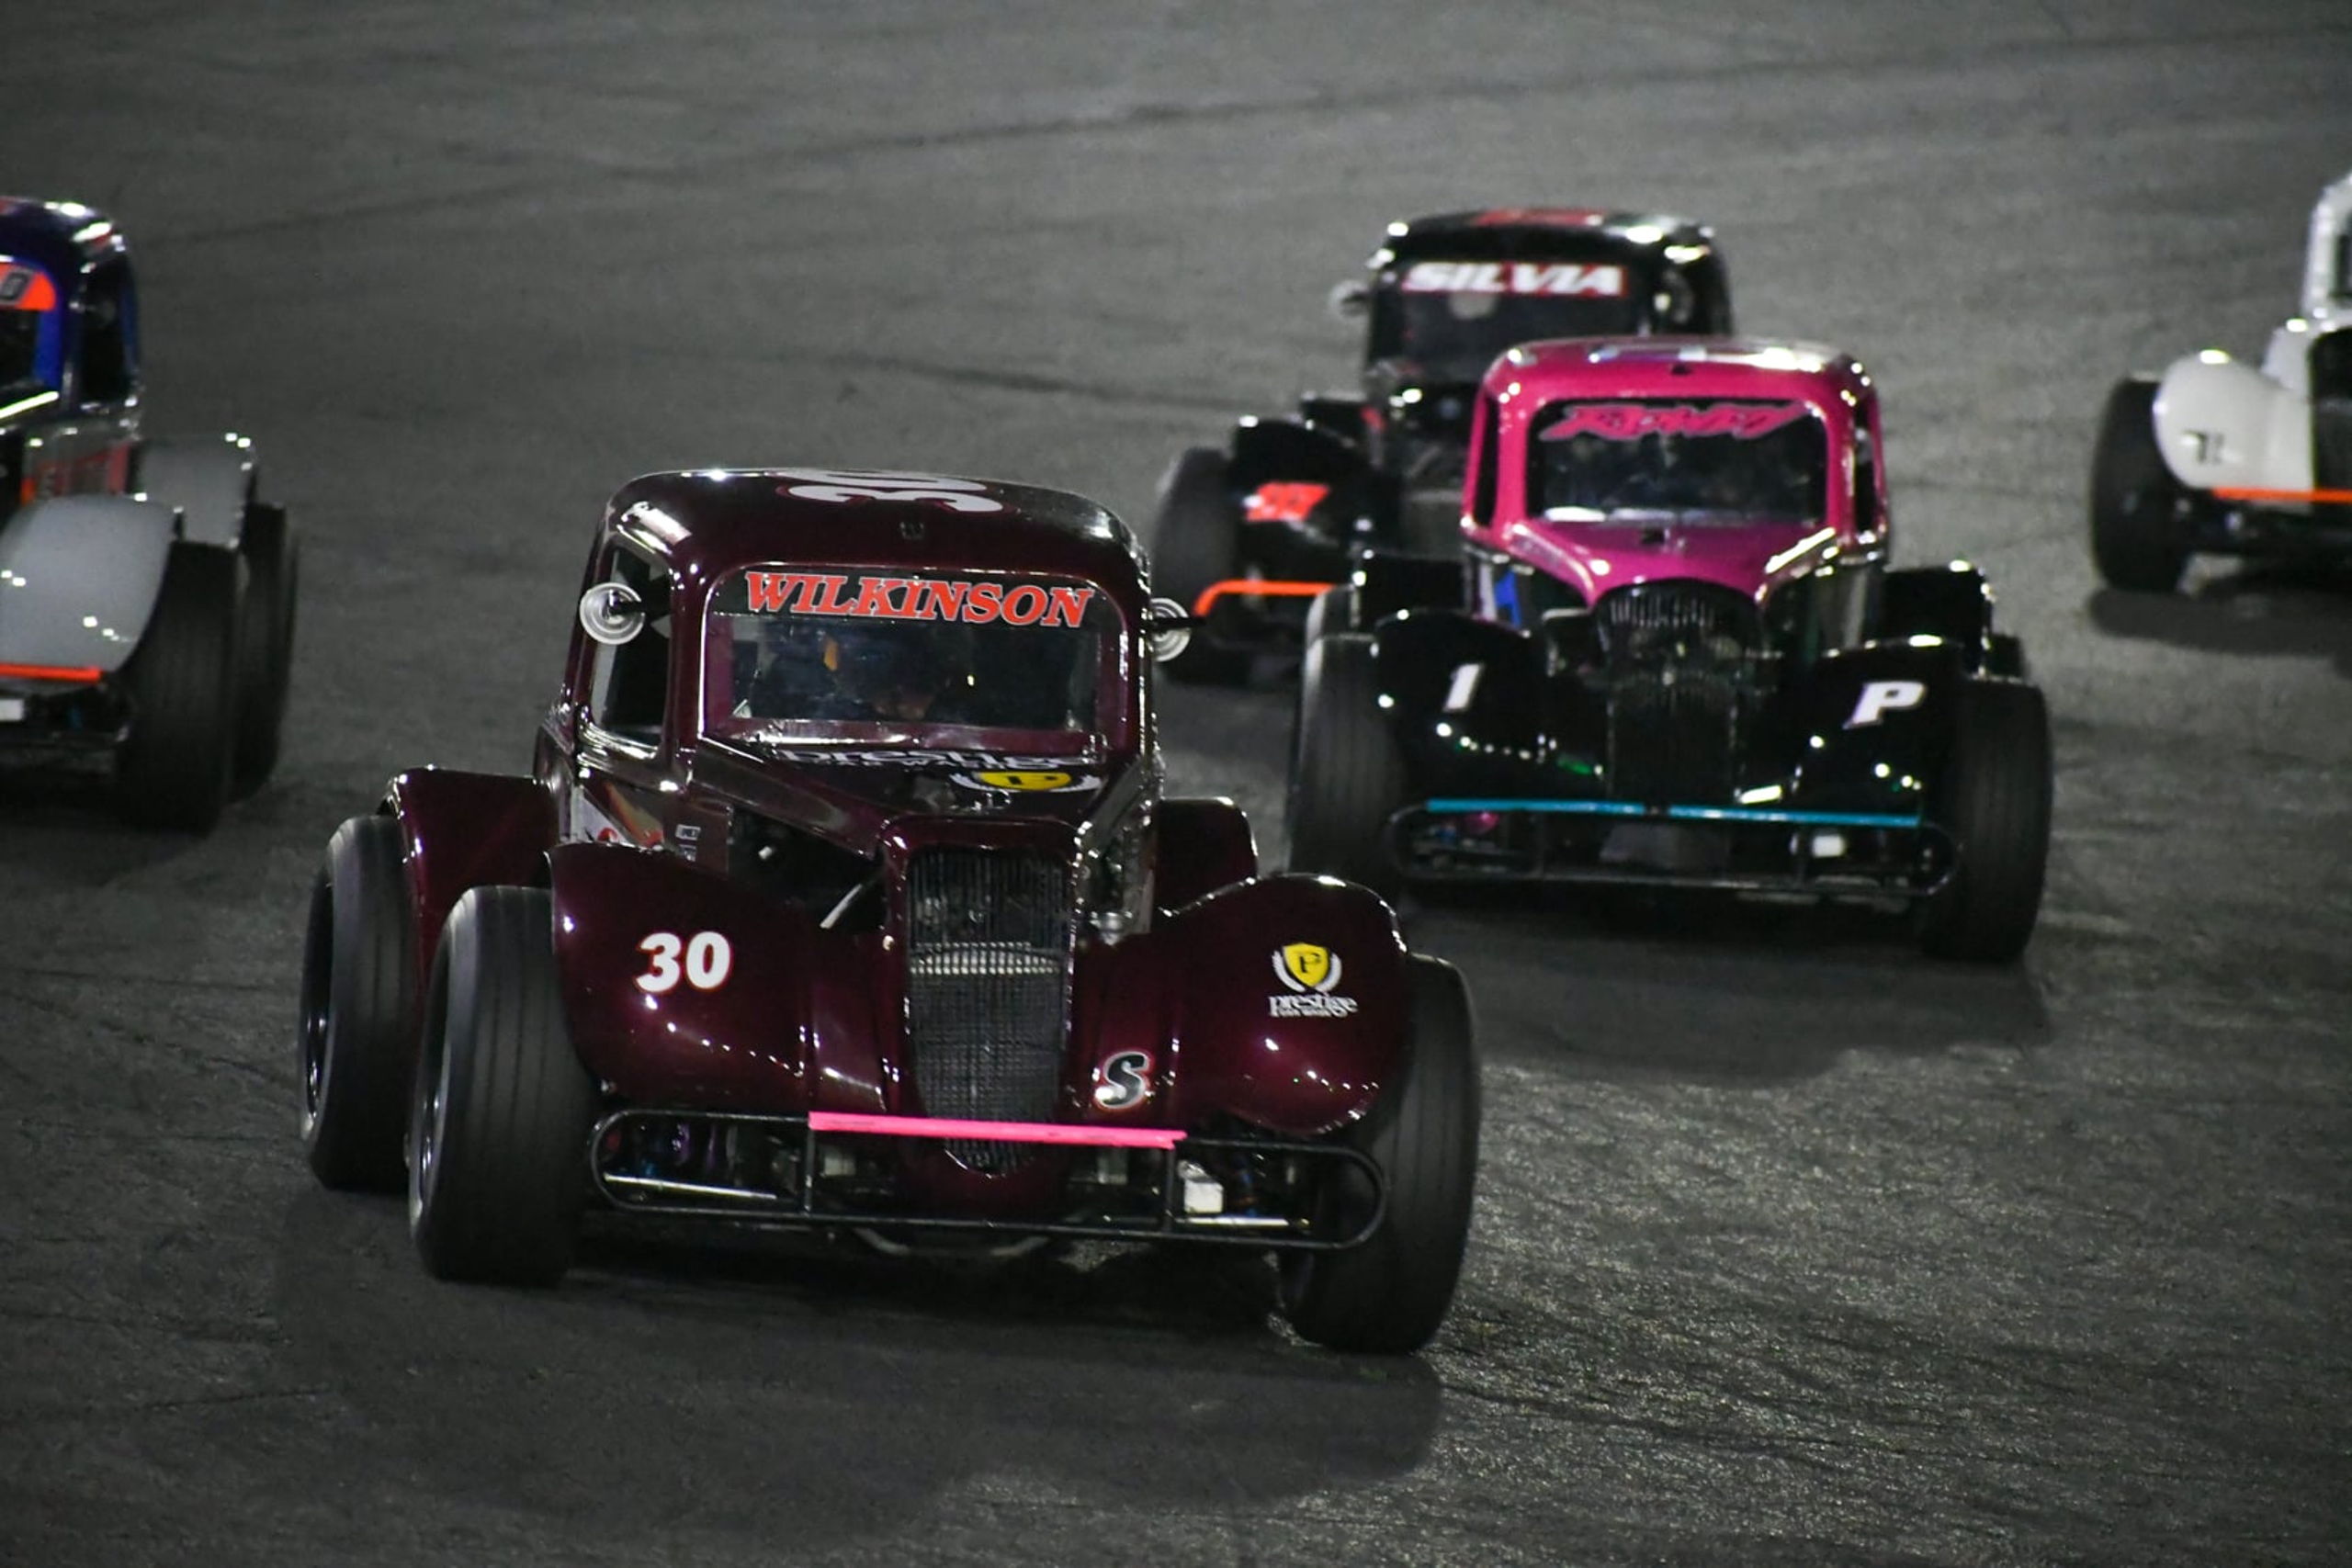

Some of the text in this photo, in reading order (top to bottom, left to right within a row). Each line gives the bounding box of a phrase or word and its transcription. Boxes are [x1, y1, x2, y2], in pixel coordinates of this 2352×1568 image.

[1404, 261, 1624, 295] SILVIA
[745, 570, 1094, 627] WILKINSON
[1843, 681, 1928, 729] P
[636, 931, 730, 993] 30
[1095, 1051, 1149, 1110] S
